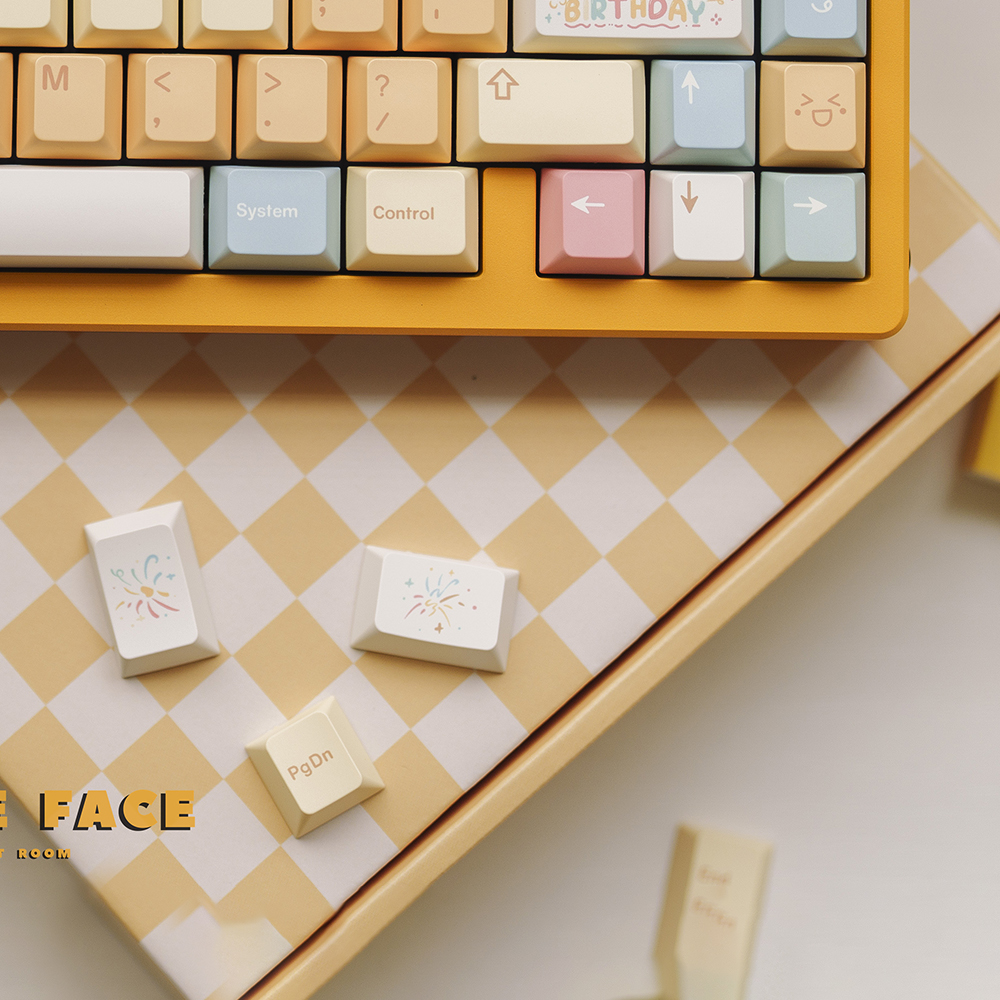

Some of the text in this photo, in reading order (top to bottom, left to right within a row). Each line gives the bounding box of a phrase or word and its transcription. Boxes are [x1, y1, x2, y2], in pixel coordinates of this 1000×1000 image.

[42, 63, 69, 92] M
[153, 71, 172, 93] <
[264, 71, 282, 94] >
[374, 73, 390, 97] ?
[375, 111, 390, 132] /
[236, 202, 298, 221] System
[373, 205, 435, 221] Control
[287, 749, 334, 781] PgDn
